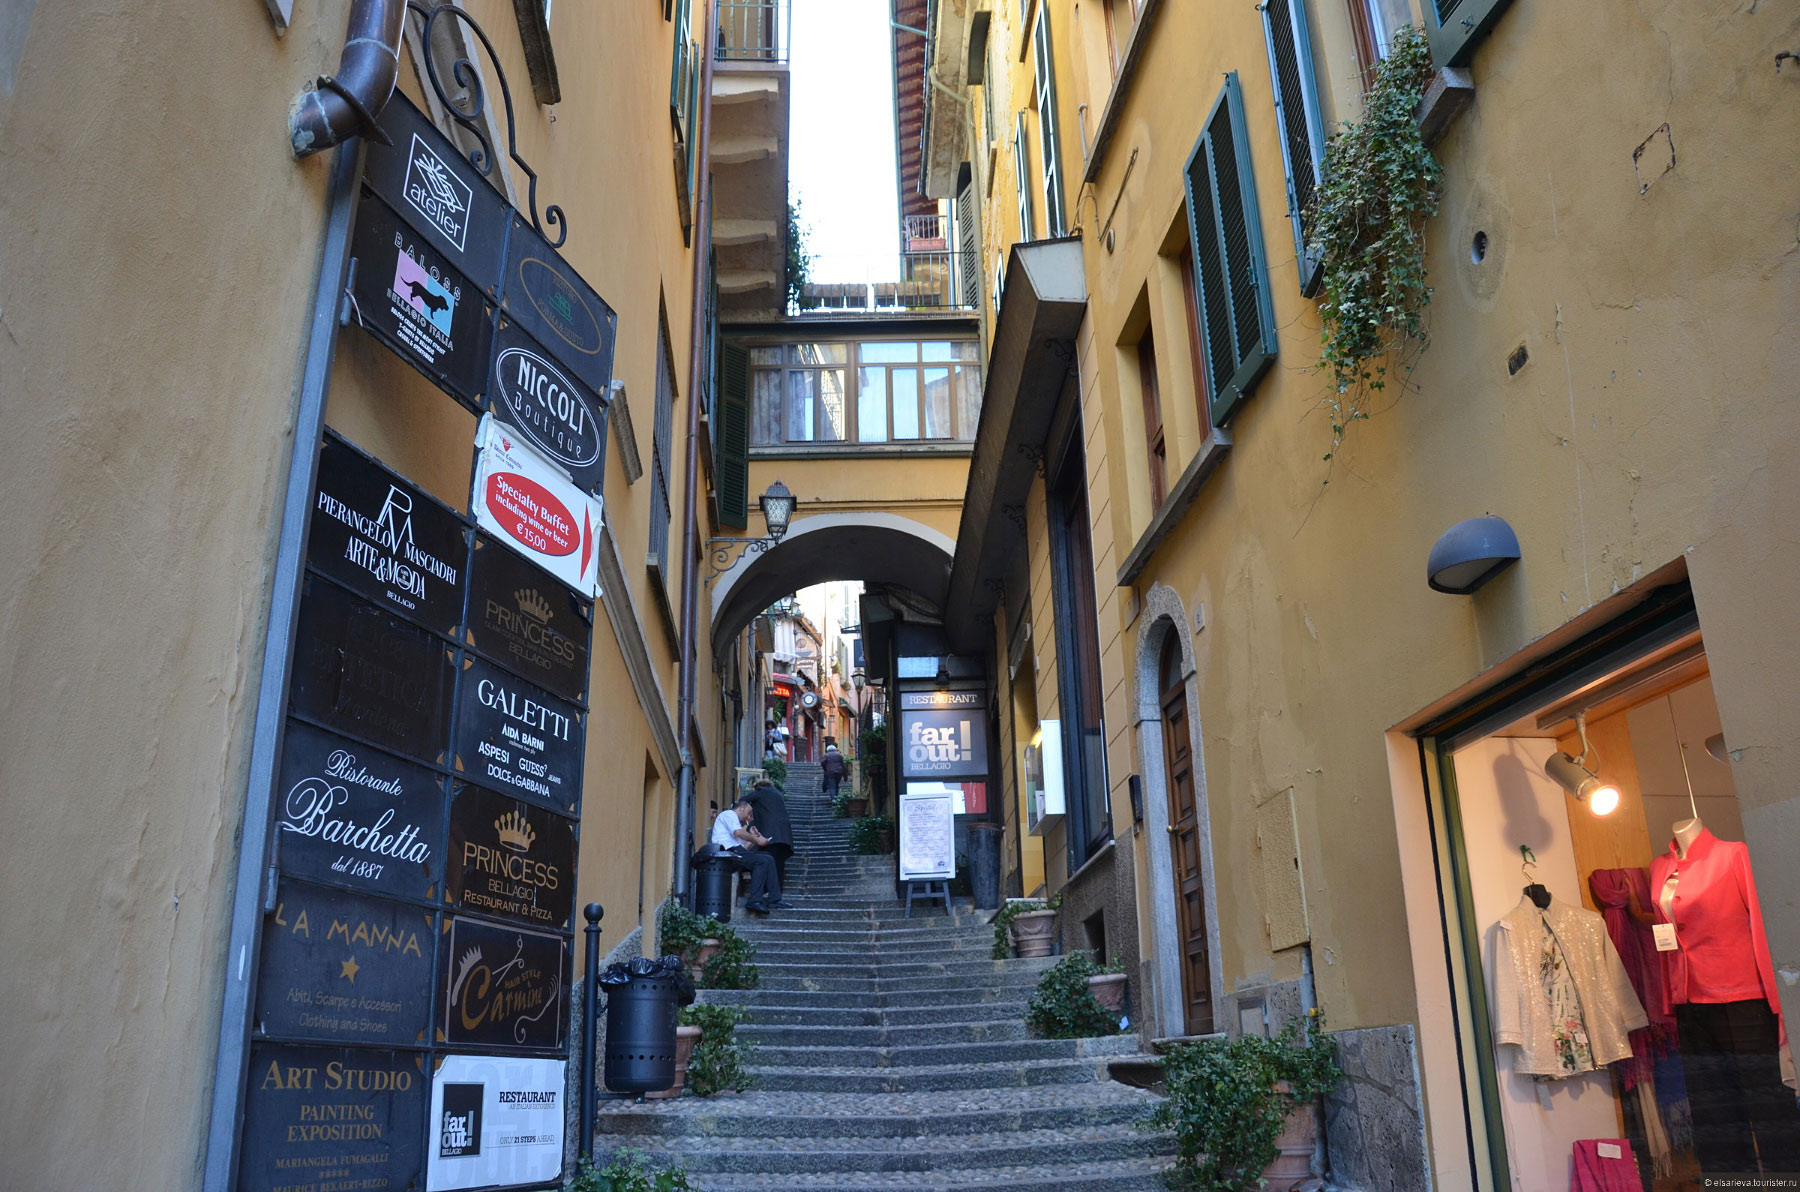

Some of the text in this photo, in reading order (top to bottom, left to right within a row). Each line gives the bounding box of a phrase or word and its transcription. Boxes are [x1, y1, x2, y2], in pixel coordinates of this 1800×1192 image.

[411, 184, 461, 237] atelier
[395, 231, 461, 301] BALOSS
[387, 288, 453, 351] BELLAGIO ITALIA
[517, 356, 585, 436] NICCOLI
[515, 391, 582, 458] Boutique
[496, 490, 568, 547] including wine or beer
[497, 476, 569, 536] Specialty Buffet
[318, 491, 456, 585] PIERANGELO MASCIADRI
[524, 528, 546, 550] 15,00
[387, 591, 415, 610] BELLAGIO
[486, 600, 574, 661] PRINCESS
[509, 642, 551, 669] BELLAGIO
[478, 680, 570, 741] GALETTI
[909, 694, 977, 704] RESTAURANT
[502, 723, 544, 751] AIDA BARNI
[325, 750, 403, 796] Ristorante
[478, 741, 510, 764] ASPESI
[548, 775, 561, 784] JEANS
[911, 762, 951, 770] BELLAGIO
[282, 777, 430, 864] Barchetta
[331, 856, 384, 880] dal 1887
[463, 841, 558, 890] PRINCESS
[488, 879, 533, 900] BELLAGIO
[464, 890, 552, 920] RESTAURANT & PIZZA
[275, 903, 421, 957] LA MANNA
[505, 976, 520, 989] HAIR
[521, 969, 541, 982] STYLE
[316, 991, 349, 1012] Scarpe
[350, 998, 358, 1009] e
[359, 996, 401, 1012] Accessori
[462, 965, 543, 1030] Carmine
[299, 1013, 387, 1032] Clothing and Shoes
[261, 1060, 411, 1091] ART STUDIO
[499, 1091, 556, 1103] RESTAURANT
[300, 1105, 374, 1121] PAINTING
[288, 1123, 382, 1142] EXPOSITION
[500, 1136, 514, 1144] ONLY
[520, 1135, 536, 1143] STEPS
[537, 1134, 554, 1142] AHEAD
[276, 1153, 389, 1169] MARIANGELA FUMAGALLI
[441, 1148, 463, 1156] BELLAGIO
